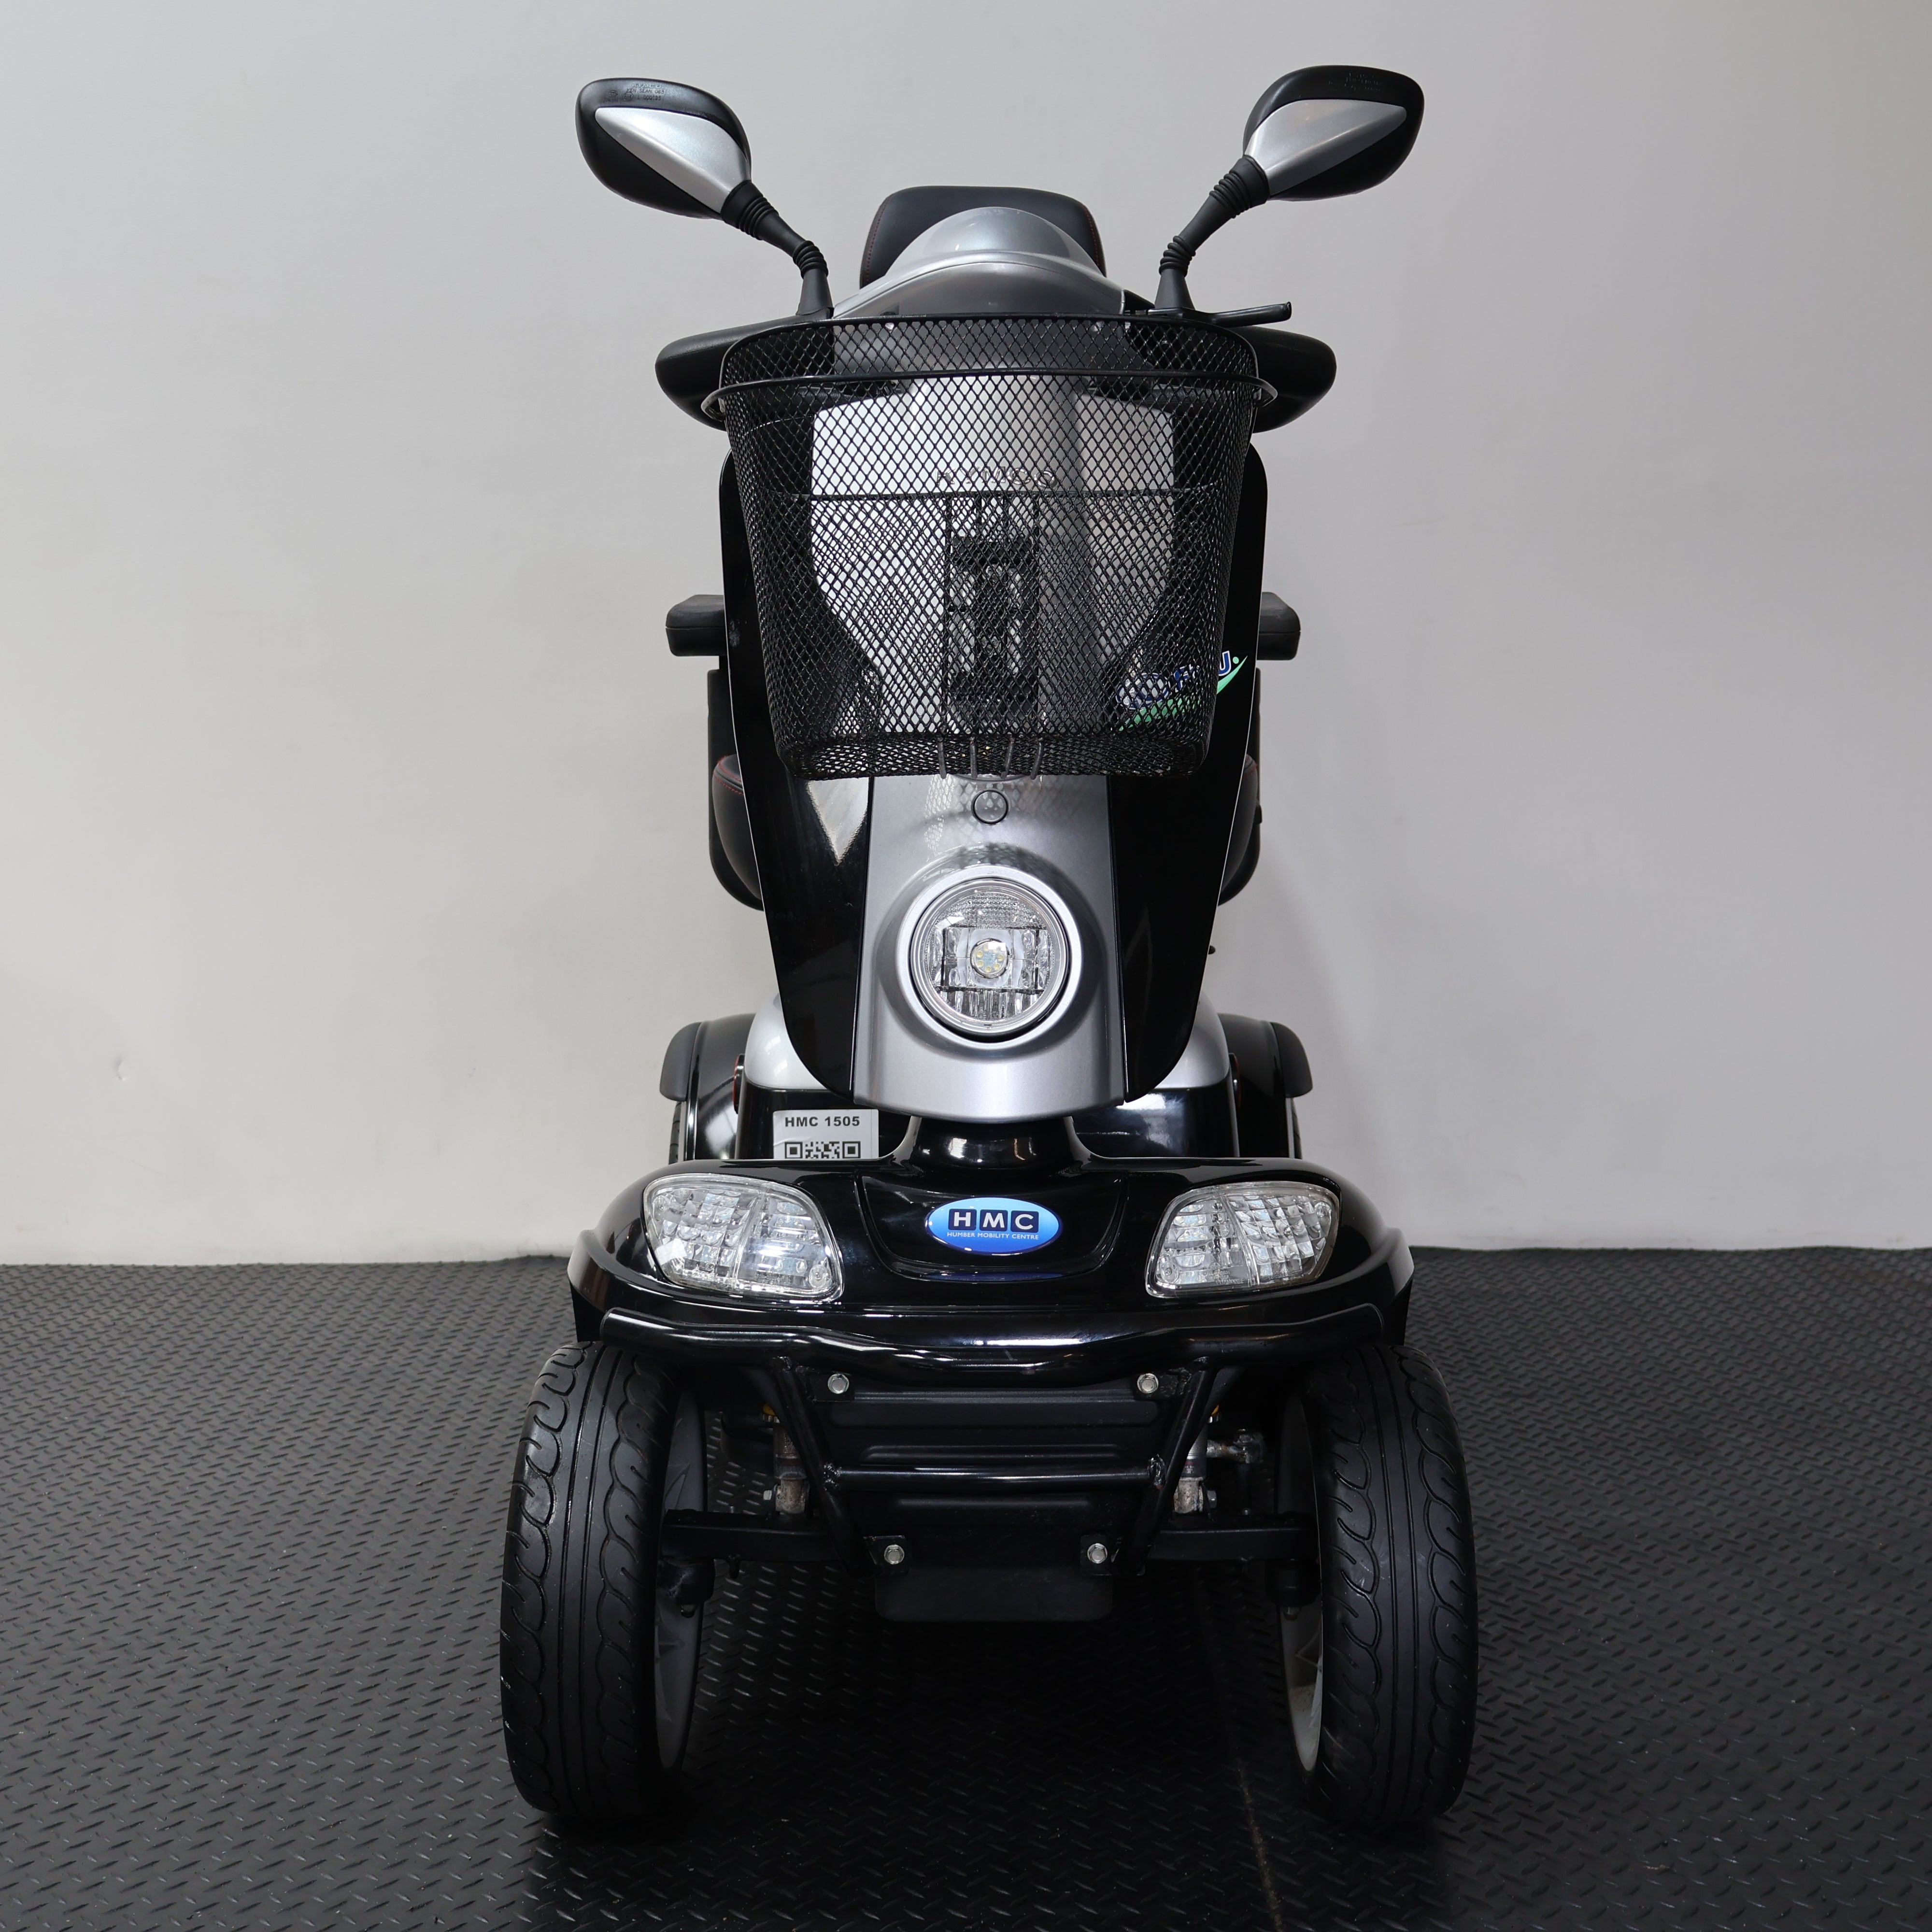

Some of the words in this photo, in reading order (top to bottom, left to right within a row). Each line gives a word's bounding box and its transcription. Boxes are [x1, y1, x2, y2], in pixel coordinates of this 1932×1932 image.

[785, 1116, 818, 1127] HMC
[824, 1116, 860, 1126] 1505
[953, 1211, 1034, 1230] HMC
